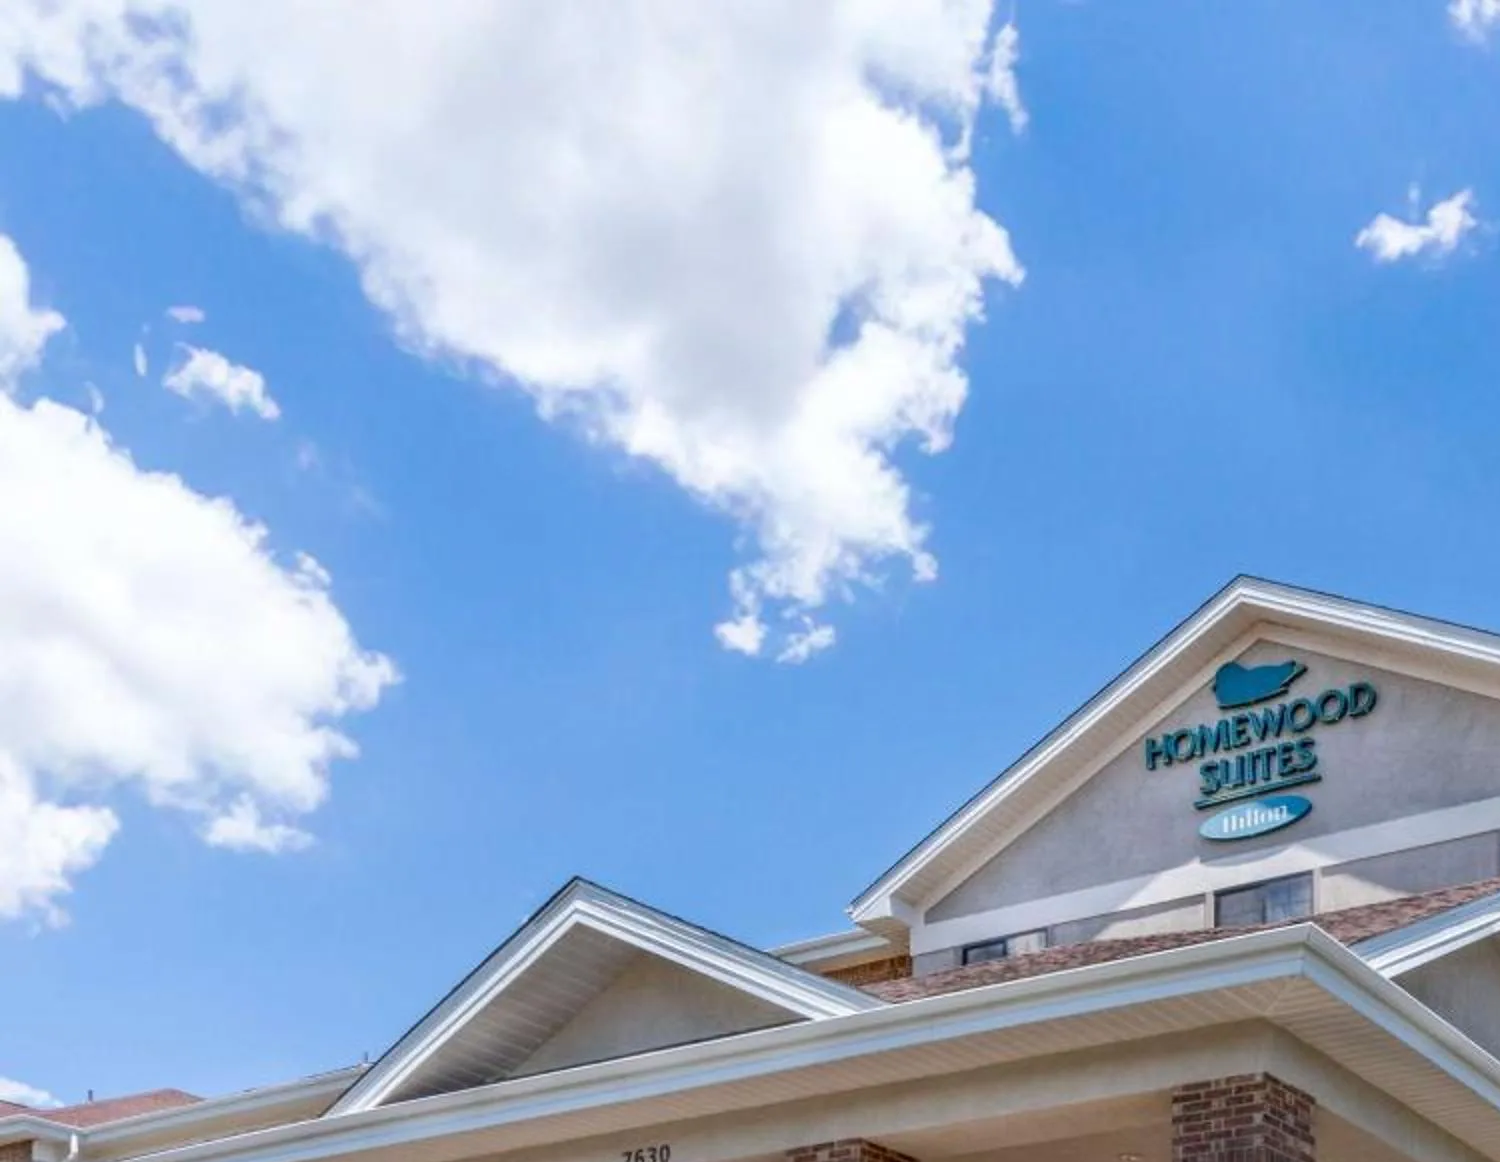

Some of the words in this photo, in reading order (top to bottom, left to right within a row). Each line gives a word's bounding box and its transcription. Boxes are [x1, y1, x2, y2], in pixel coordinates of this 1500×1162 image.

[1145, 681, 1377, 770] HOMEWOOD
[1199, 736, 1317, 795] SUITES
[1222, 804, 1288, 833] Hilton
